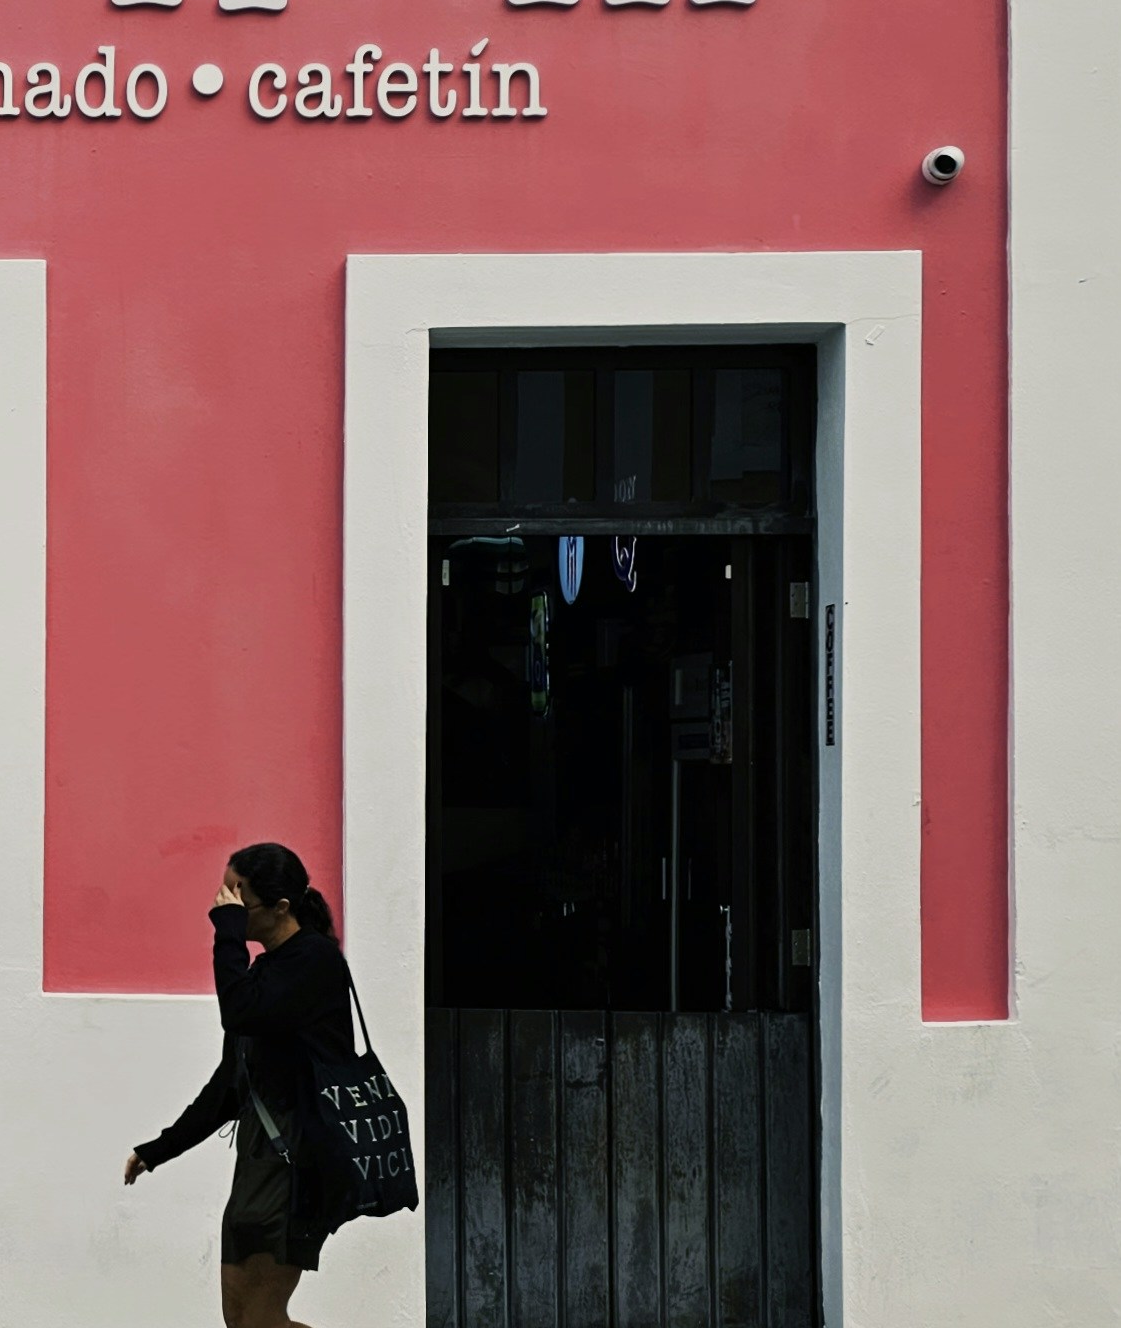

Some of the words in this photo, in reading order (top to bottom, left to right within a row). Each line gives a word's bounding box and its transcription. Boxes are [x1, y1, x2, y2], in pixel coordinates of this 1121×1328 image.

[248, 37, 548, 119] cafetín
[825, 604, 835, 746] COFFEE
[320, 1073, 396, 1111] VENI
[339, 1110, 403, 1144] VIDI
[352, 1147, 411, 1181] VICI
